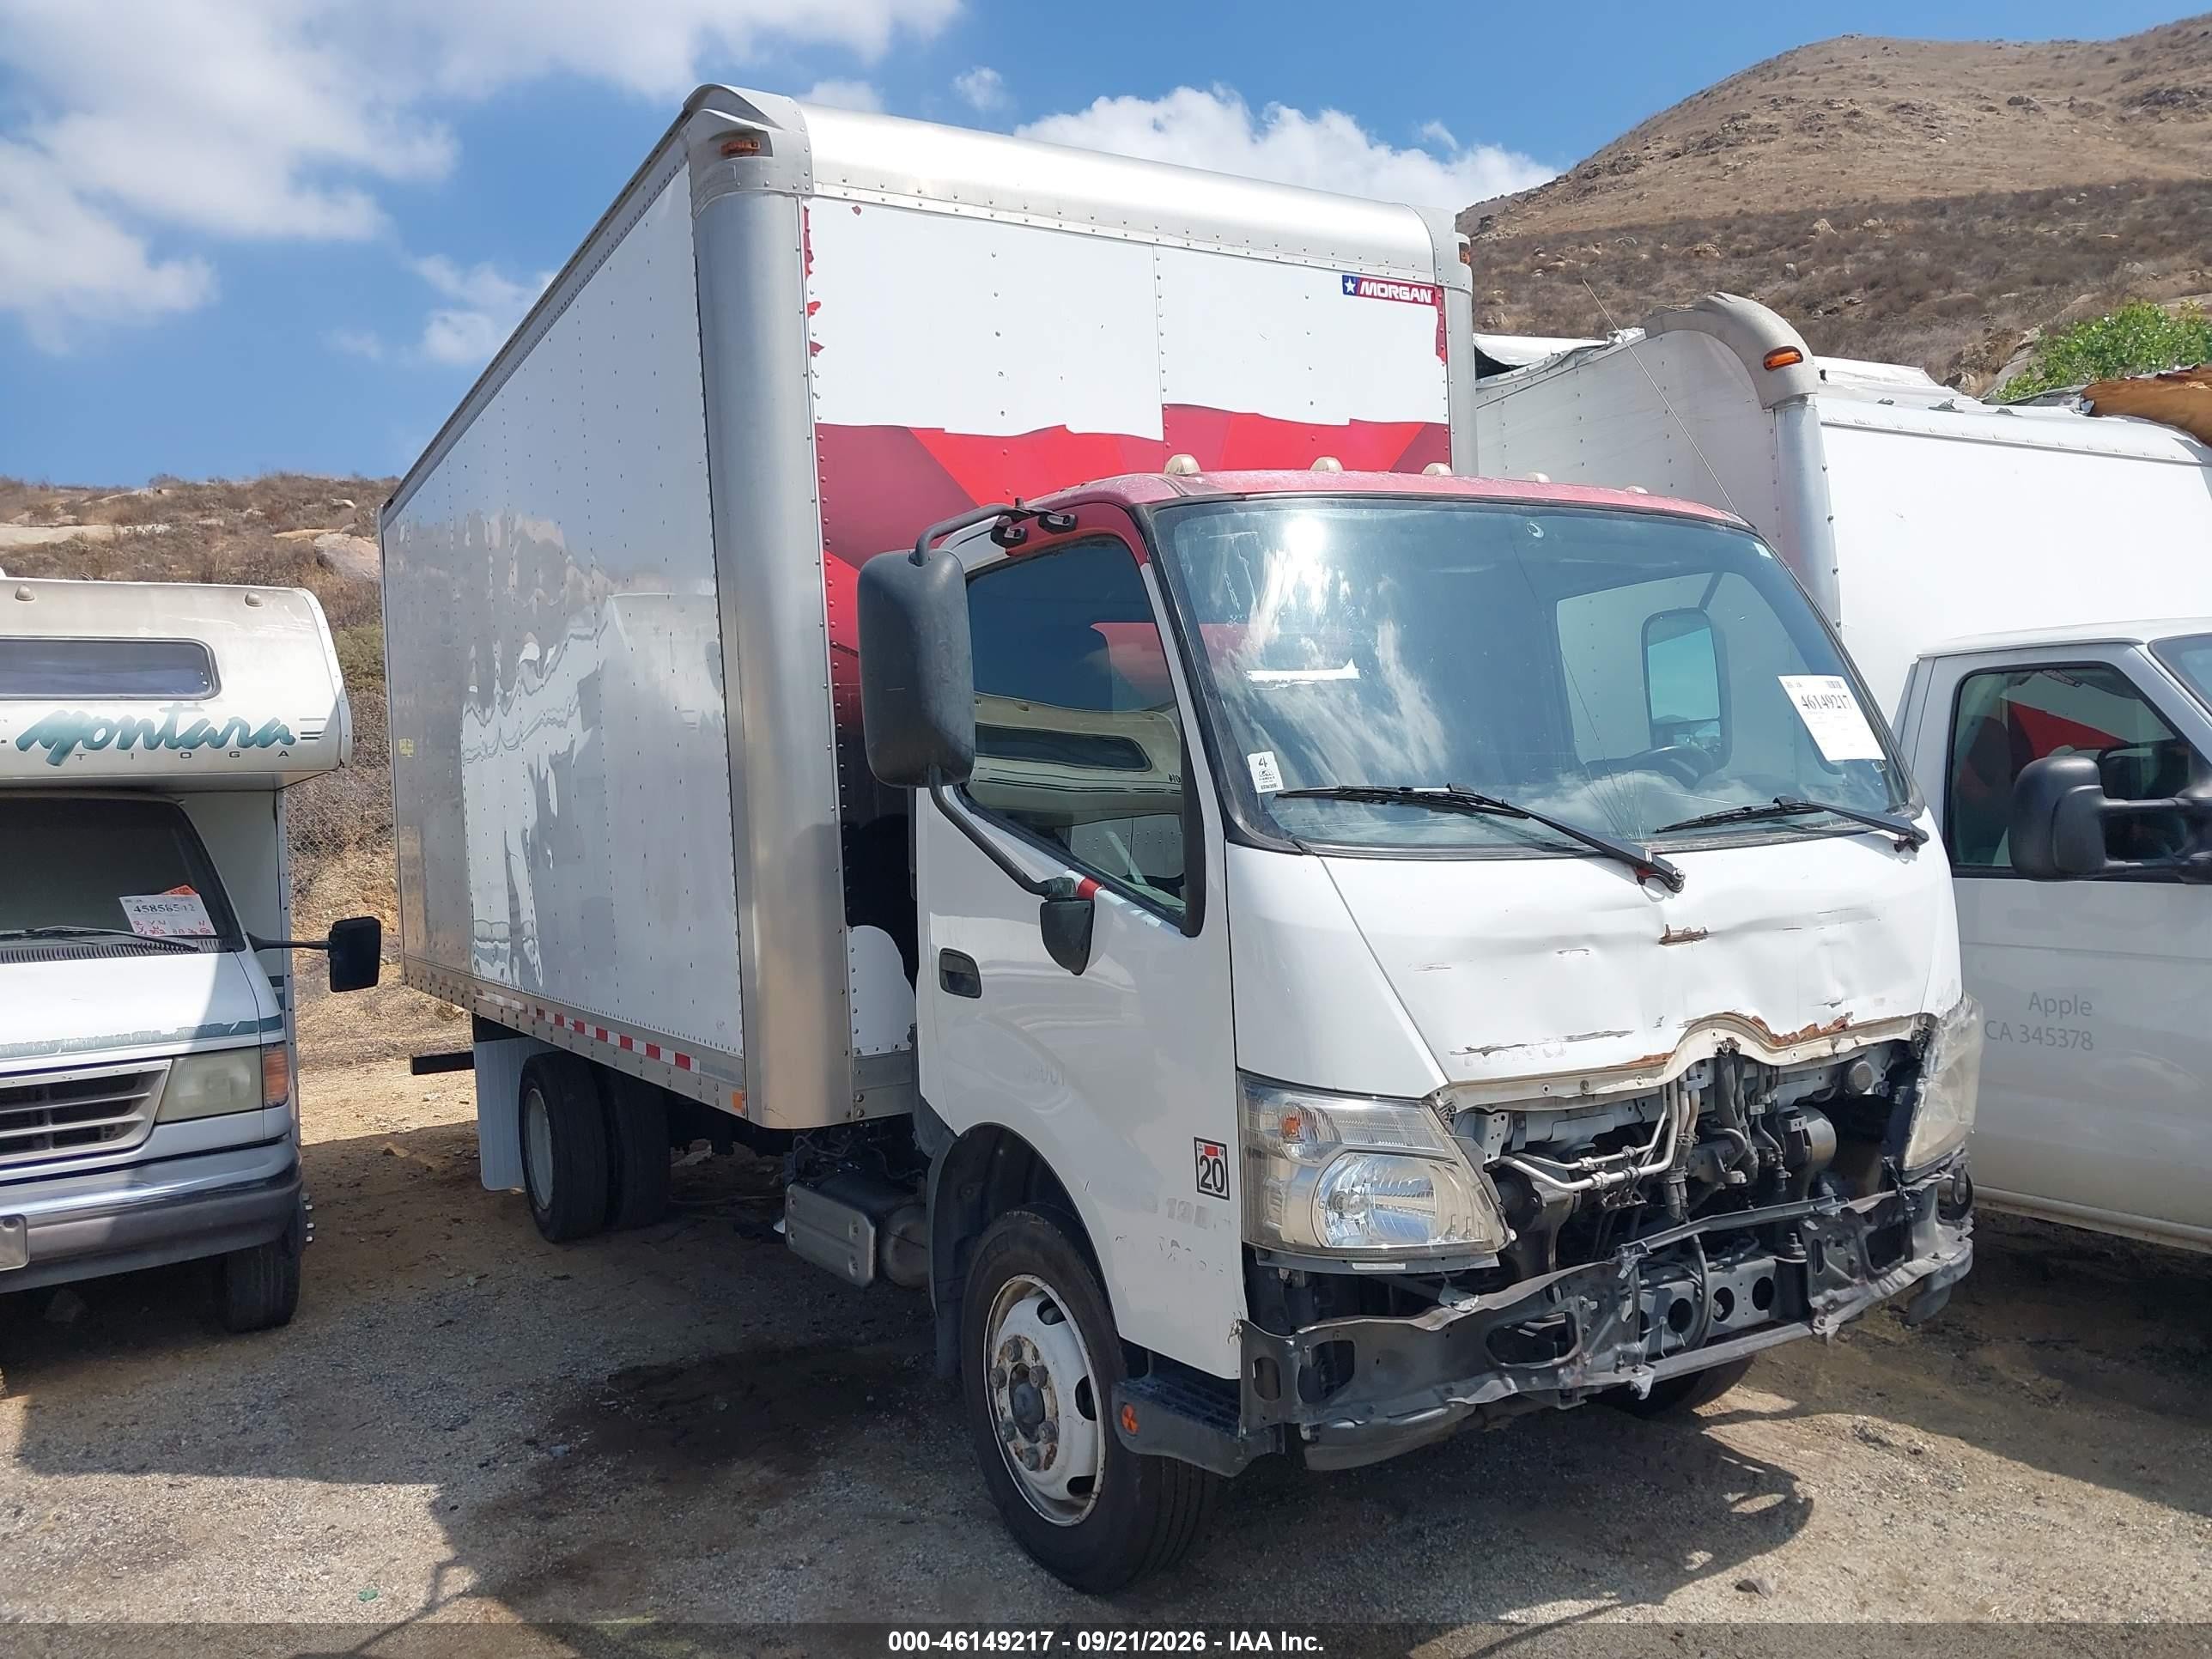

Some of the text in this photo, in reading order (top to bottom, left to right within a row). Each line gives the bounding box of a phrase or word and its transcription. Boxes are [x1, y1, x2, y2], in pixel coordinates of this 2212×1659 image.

[1359, 281, 1432, 304] MORGAN
[1801, 694, 1853, 709] 46149217
[15, 702, 296, 767] Montara
[76, 750, 289, 761] TIOGA
[1258, 757, 1267, 768] 4
[133, 903, 195, 913] 45856512
[2028, 992, 2093, 1019] Apple
[1984, 1020, 2094, 1051] CA 345378
[1199, 1155, 1225, 1193] 20
